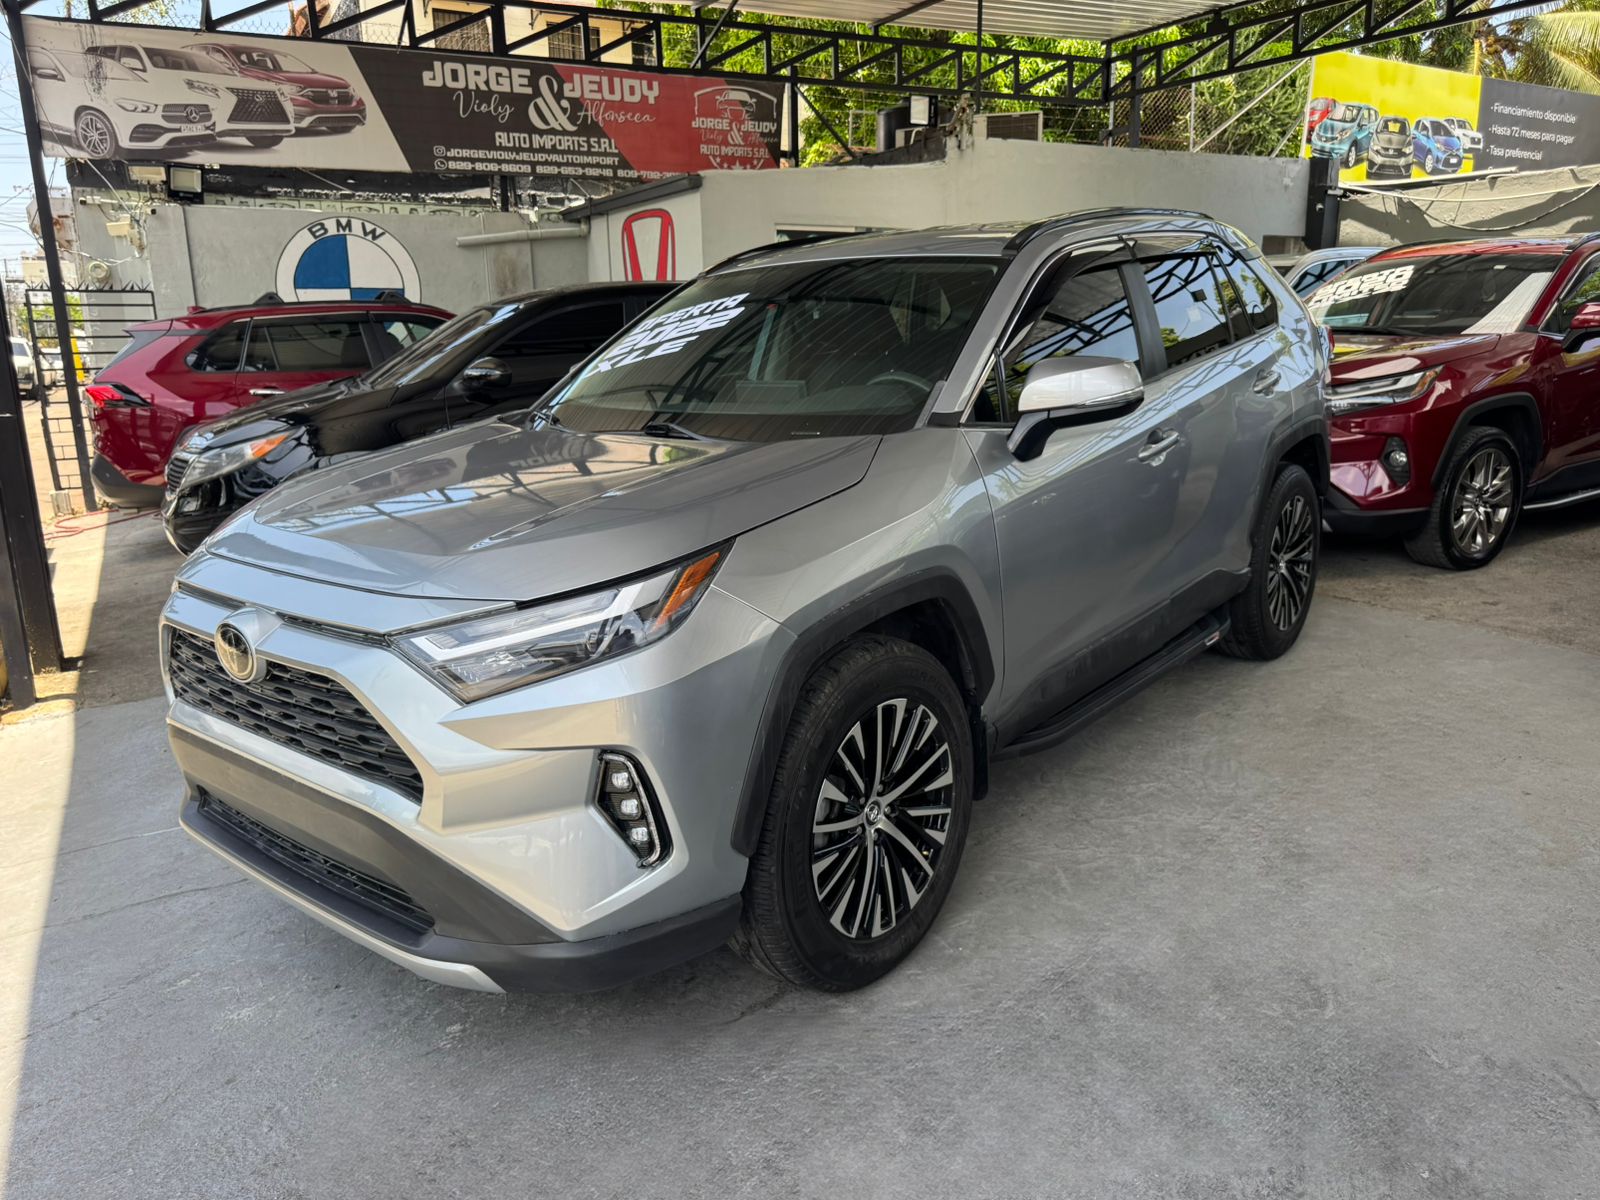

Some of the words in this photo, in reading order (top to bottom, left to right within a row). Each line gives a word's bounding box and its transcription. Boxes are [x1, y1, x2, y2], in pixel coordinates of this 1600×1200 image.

[422, 61, 533, 95] JORGE
[528, 75, 579, 132] &
[563, 73, 660, 105] JEUDY
[453, 90, 515, 123] Violy
[576, 100, 656, 128] Alfonseca
[1493, 102, 1544, 120] Financiamiento
[1543, 111, 1577, 124] disponible
[692, 117, 730, 131] JORGE
[741, 121, 777, 134] JEUDY
[1491, 124, 1511, 137] Hasta
[1511, 126, 1520, 138] 72
[1520, 130, 1541, 141] meses
[1541, 133, 1556, 142] para
[1555, 135, 1575, 146] pagar
[495, 132, 530, 148] AUTO
[532, 134, 588, 152] IMPORTS
[700, 144, 720, 155] AUTO
[721, 146, 753, 157] IMPORTS
[1489, 145, 1504, 157] Tasa
[1504, 148, 1543, 161] preferencial
[447, 148, 620, 166] JORGEVIOLYJEUDYAUTOIMPORT
[306, 217, 386, 242] BMW
[629, 292, 751, 336] OFERTA
[602, 306, 746, 360] 2022
[582, 335, 700, 380] XLE
